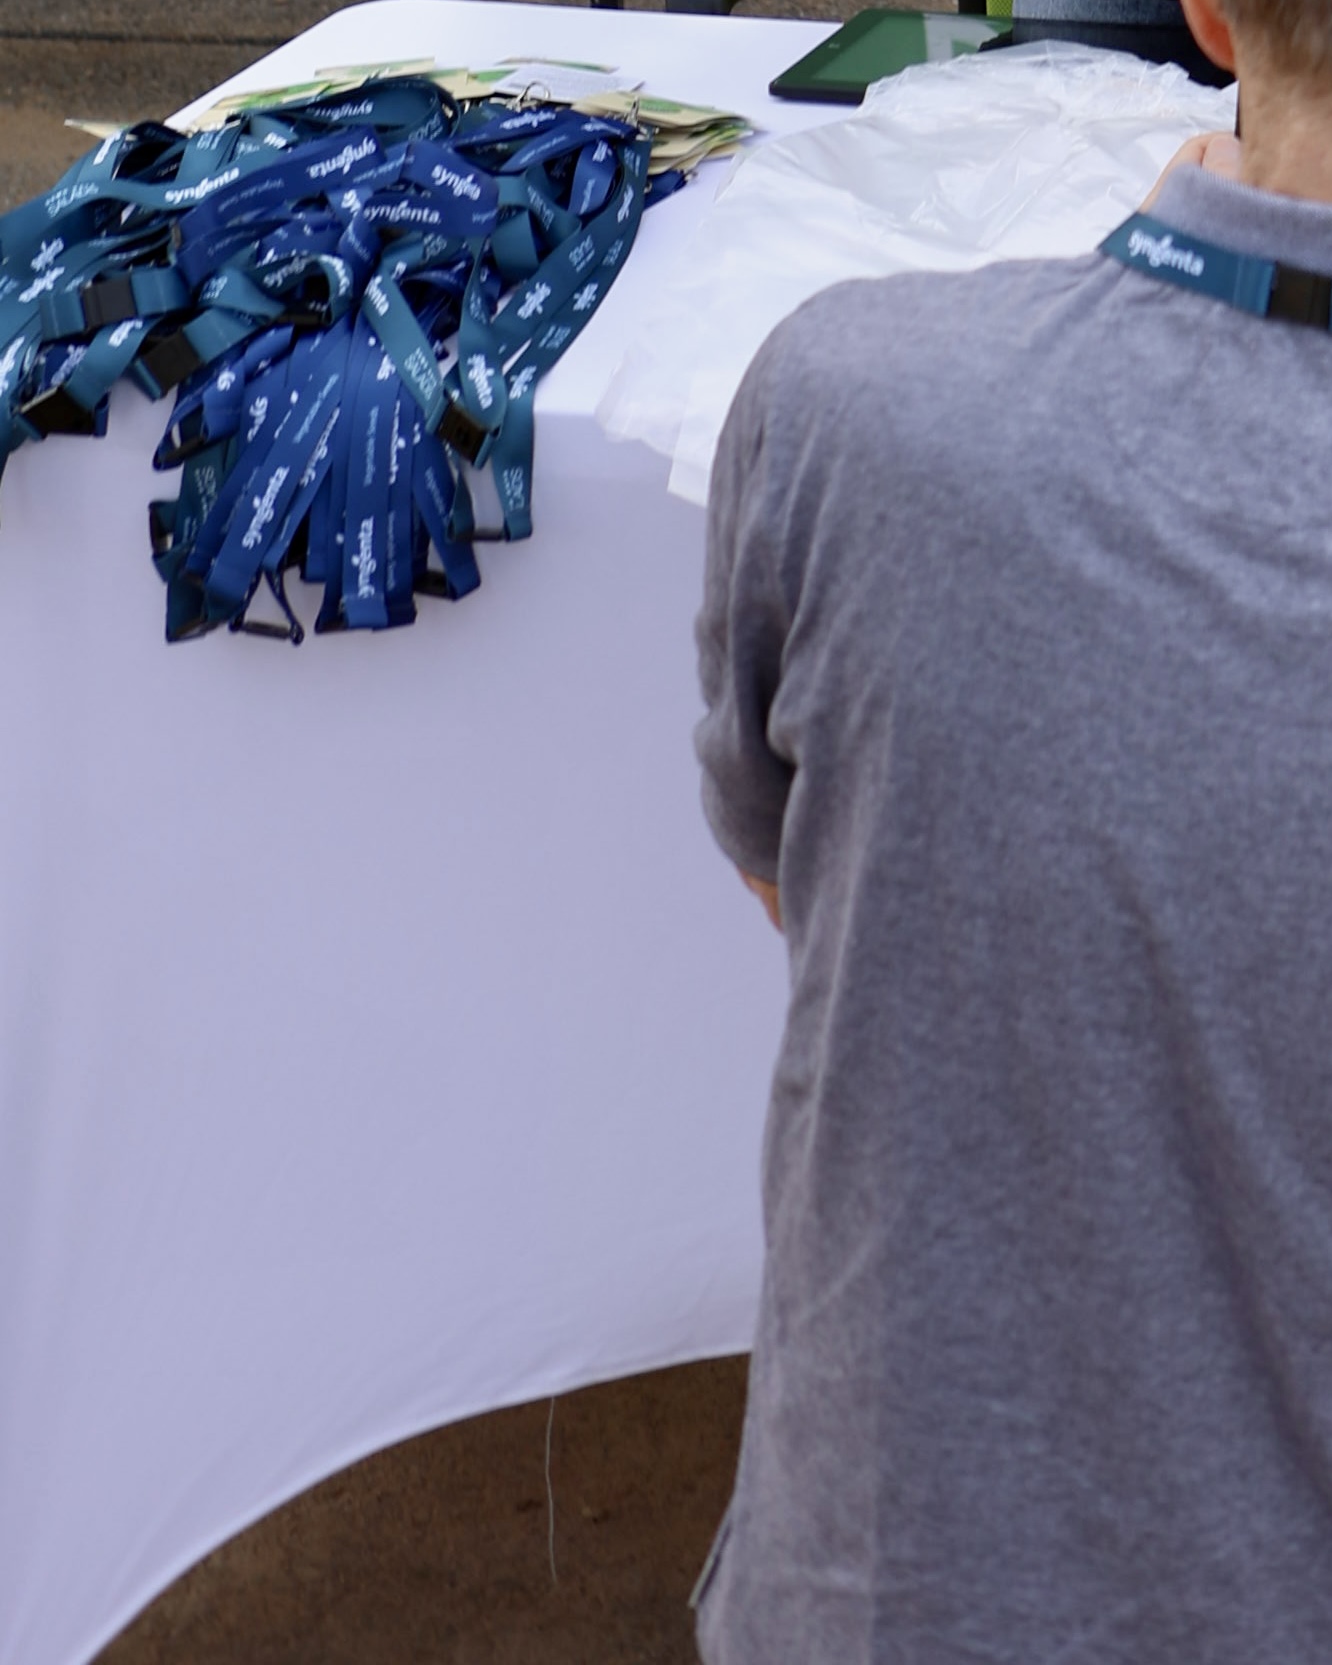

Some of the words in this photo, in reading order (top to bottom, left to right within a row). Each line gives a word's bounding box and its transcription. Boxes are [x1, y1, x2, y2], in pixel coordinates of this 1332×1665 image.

[306, 136, 377, 179] syngenta
[164, 167, 240, 205] syngenta
[363, 200, 441, 224] syngenta
[1128, 228, 1204, 276] syngenta
[242, 466, 290, 550] syngenta
[352, 517, 377, 599] yngenta
